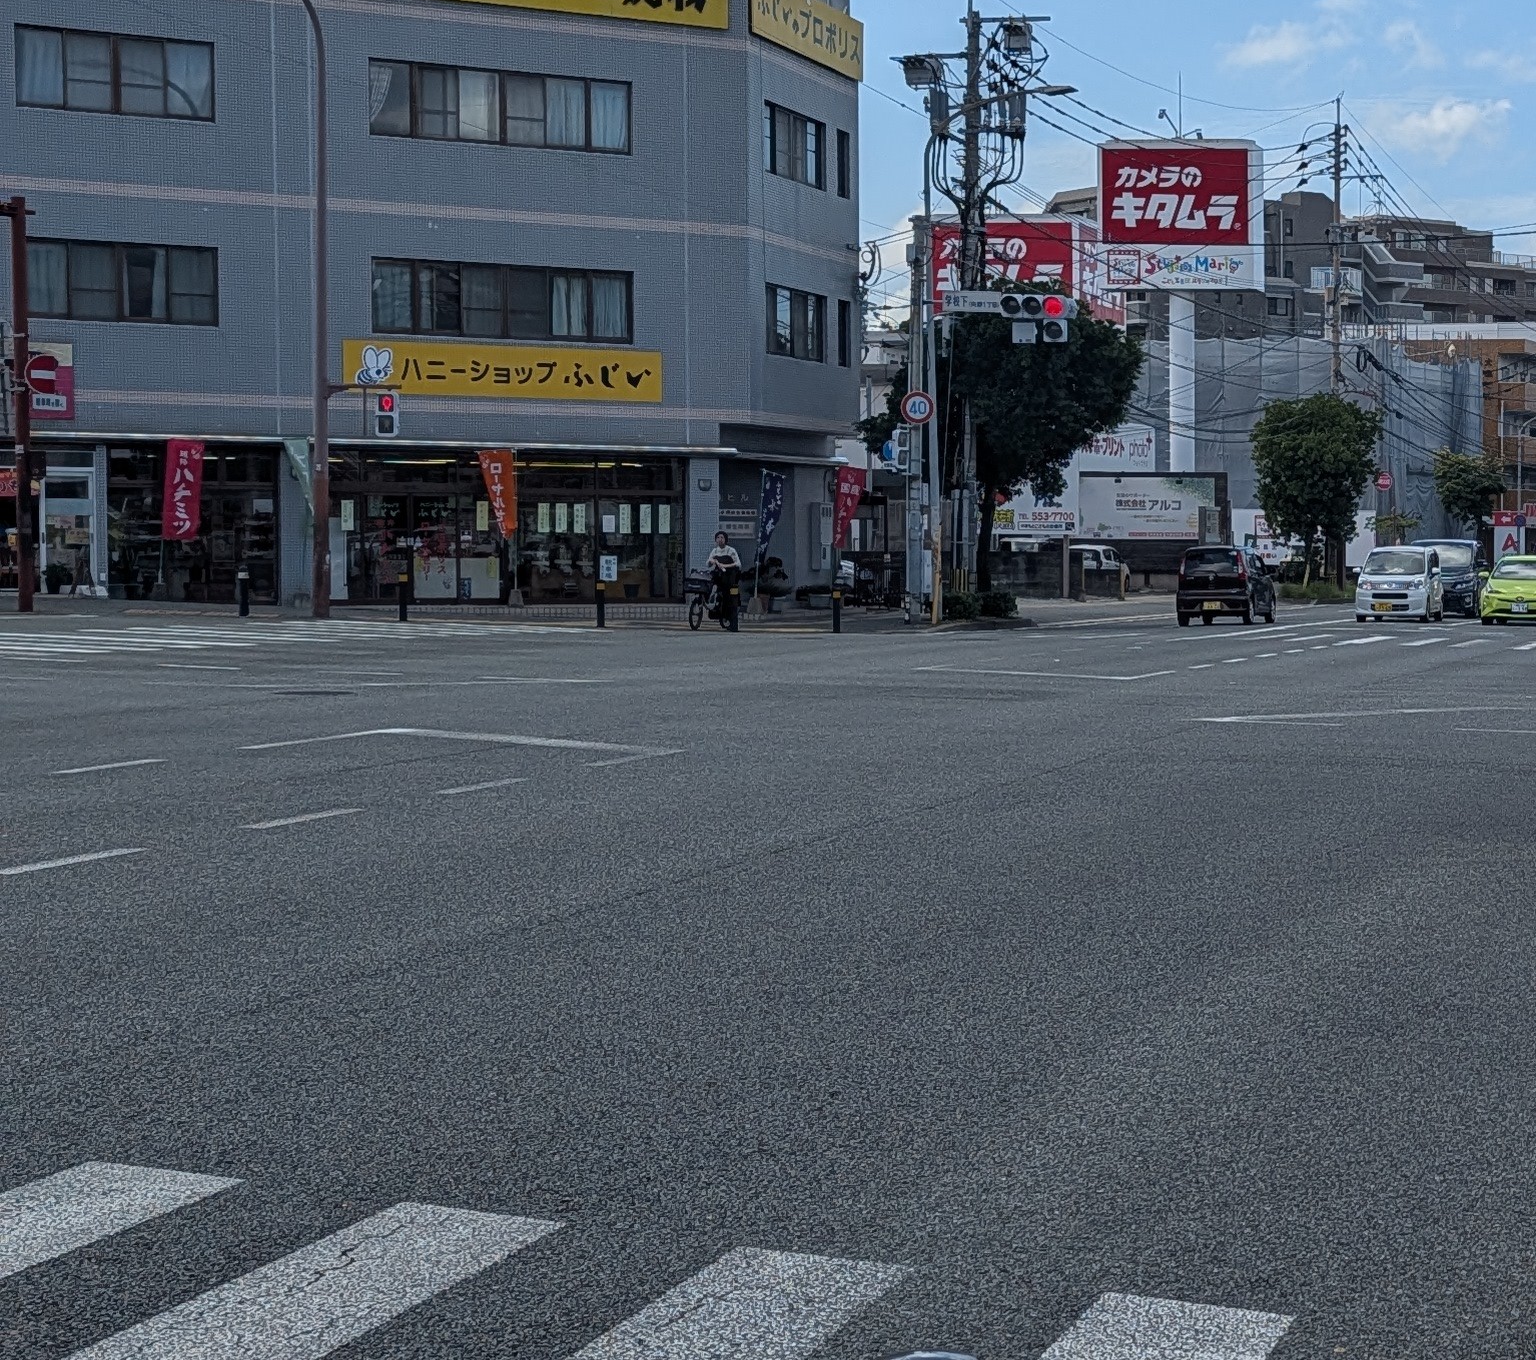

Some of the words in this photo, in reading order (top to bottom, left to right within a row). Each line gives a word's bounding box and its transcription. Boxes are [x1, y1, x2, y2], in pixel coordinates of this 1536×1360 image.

[1115, 167, 1202, 188] カメラの
[1111, 192, 1239, 230] キタムラ
[939, 237, 1027, 261] カラの
[401, 358, 557, 384] ハニーショップ
[563, 362, 652, 388] ふじい
[909, 400, 927, 414] 40
[173, 468, 194, 535] ハチミツ
[1116, 499, 1147, 507] 株式会社
[1149, 500, 1181, 510] アルコ
[1032, 512, 1075, 521] 553-7700
